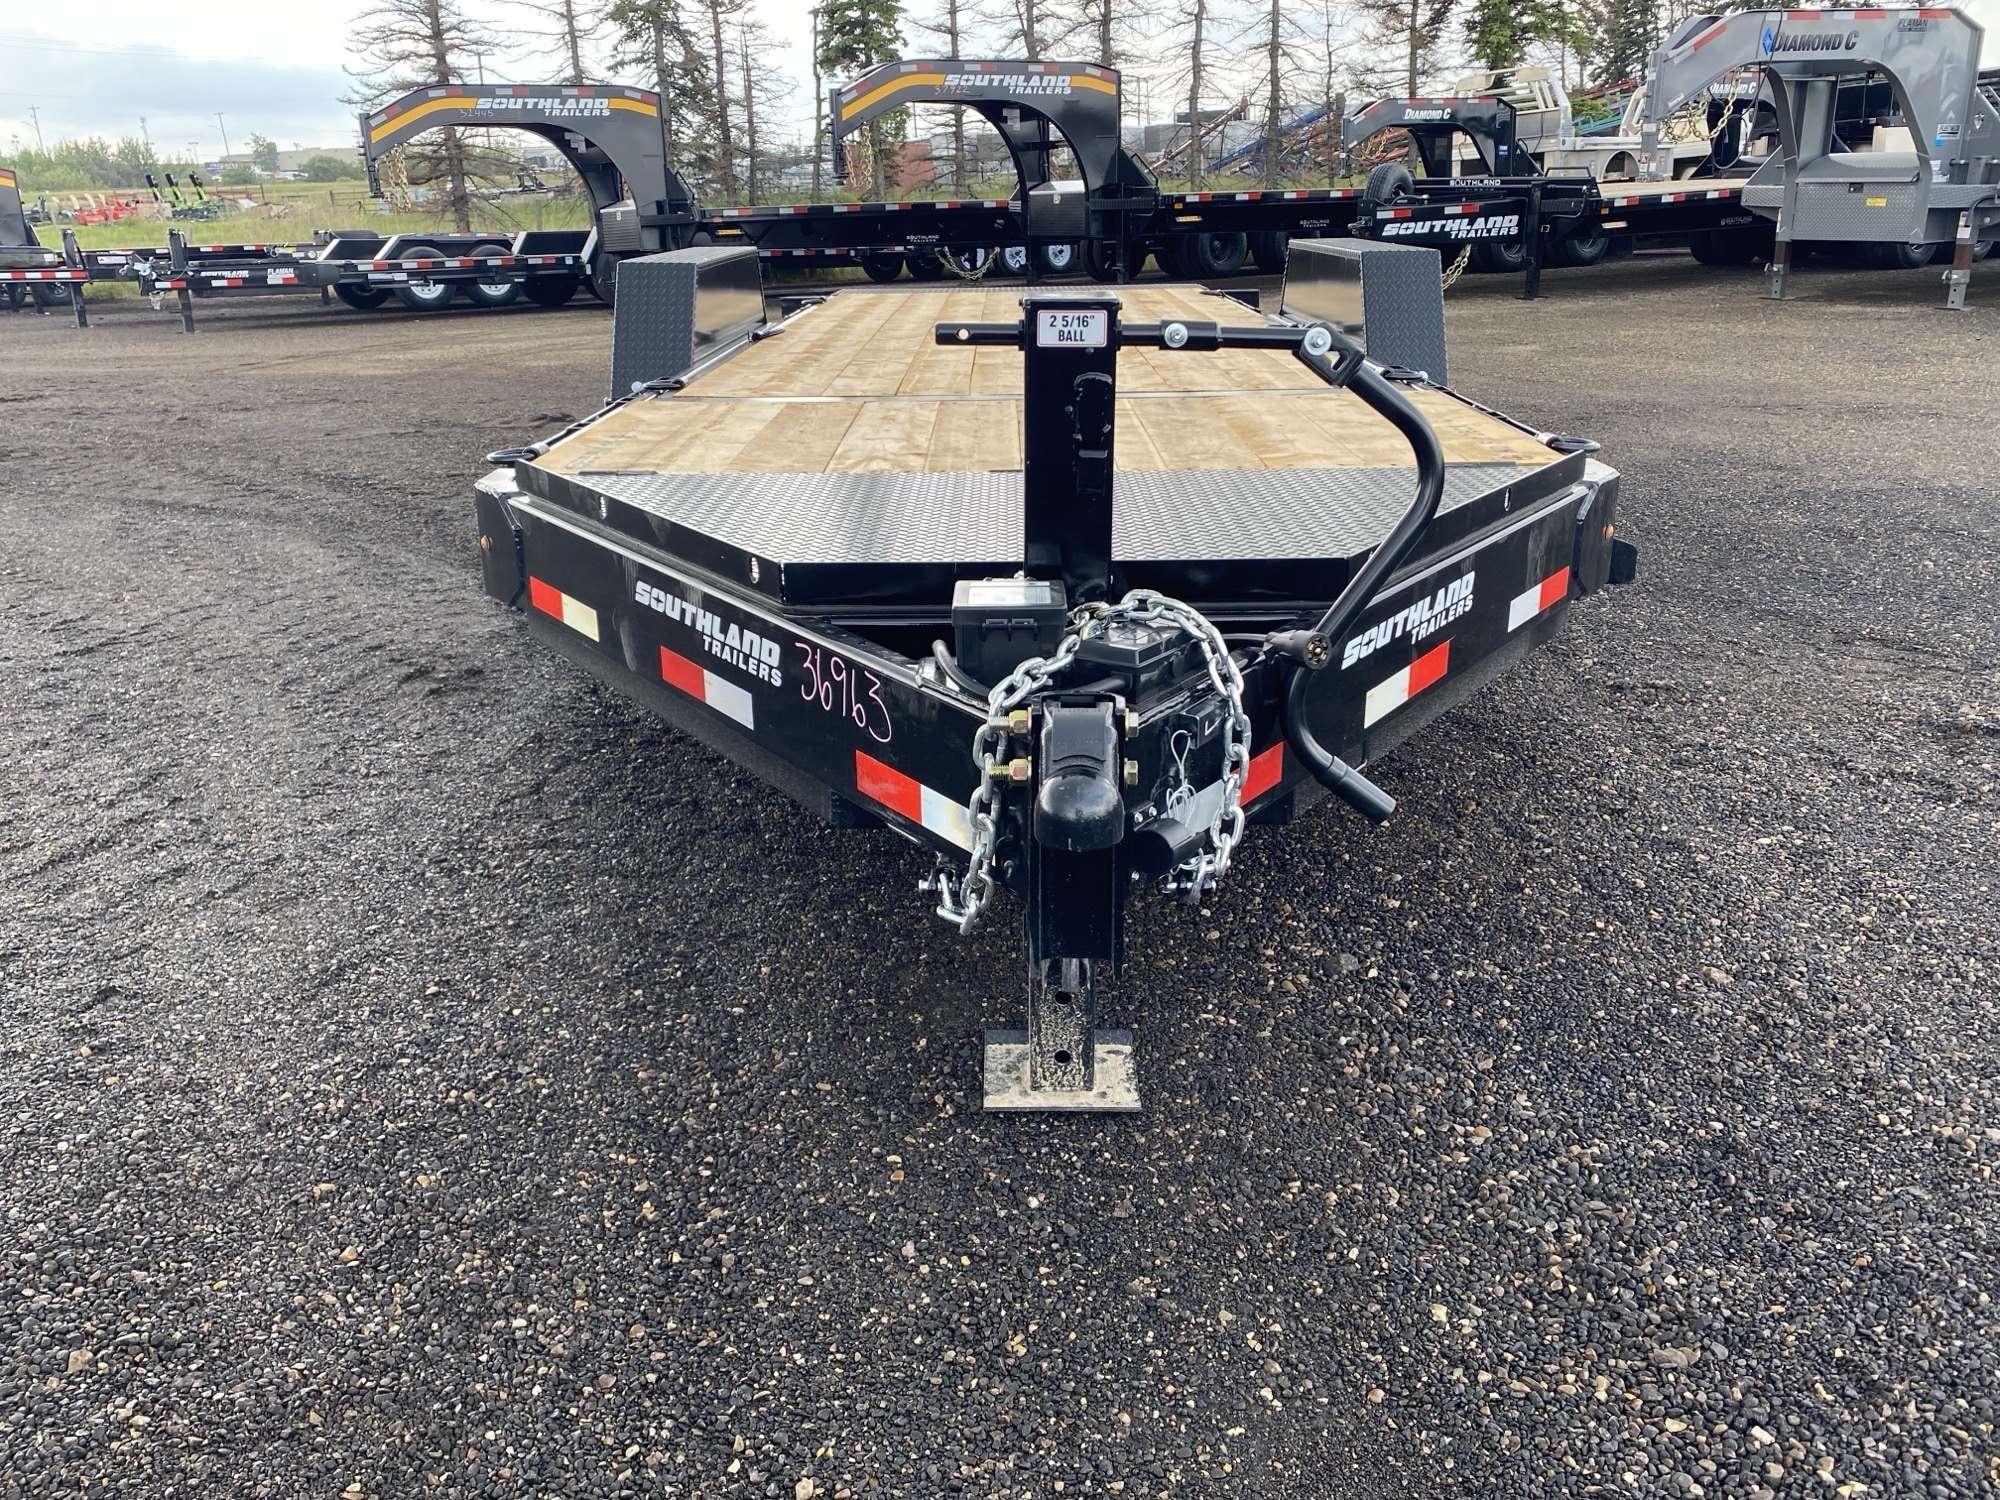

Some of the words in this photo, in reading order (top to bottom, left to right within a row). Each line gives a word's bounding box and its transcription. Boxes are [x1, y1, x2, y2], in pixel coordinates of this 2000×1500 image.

[1773, 32, 1843, 52] DIAMOND
[1844, 30, 1860, 51] C
[943, 74, 1073, 87] SOUTHLAND
[1008, 86, 1072, 95] TRAILERS
[1710, 83, 1748, 94] DIAMND
[476, 97, 609, 109] SOUTHLAND
[544, 108, 611, 117] TRAILERS
[1403, 109, 1442, 120] DIAMOND
[1442, 108, 1452, 120] C
[1449, 178, 1501, 187] SOUTHLAND
[1382, 214, 1519, 236] SOUTHLAND
[1450, 226, 1519, 239] TRAILERS
[1049, 315, 1057, 328] 2
[1062, 314, 1095, 328] 5/16"
[1058, 329, 1086, 342] BALL
[635, 580, 781, 668] SOUTHLAND
[1341, 570, 1475, 671] SOUTHLAND
[1411, 594, 1474, 645] TRAILERS
[703, 634, 782, 687] TRAILERS
[795, 642, 892, 743] 36963
